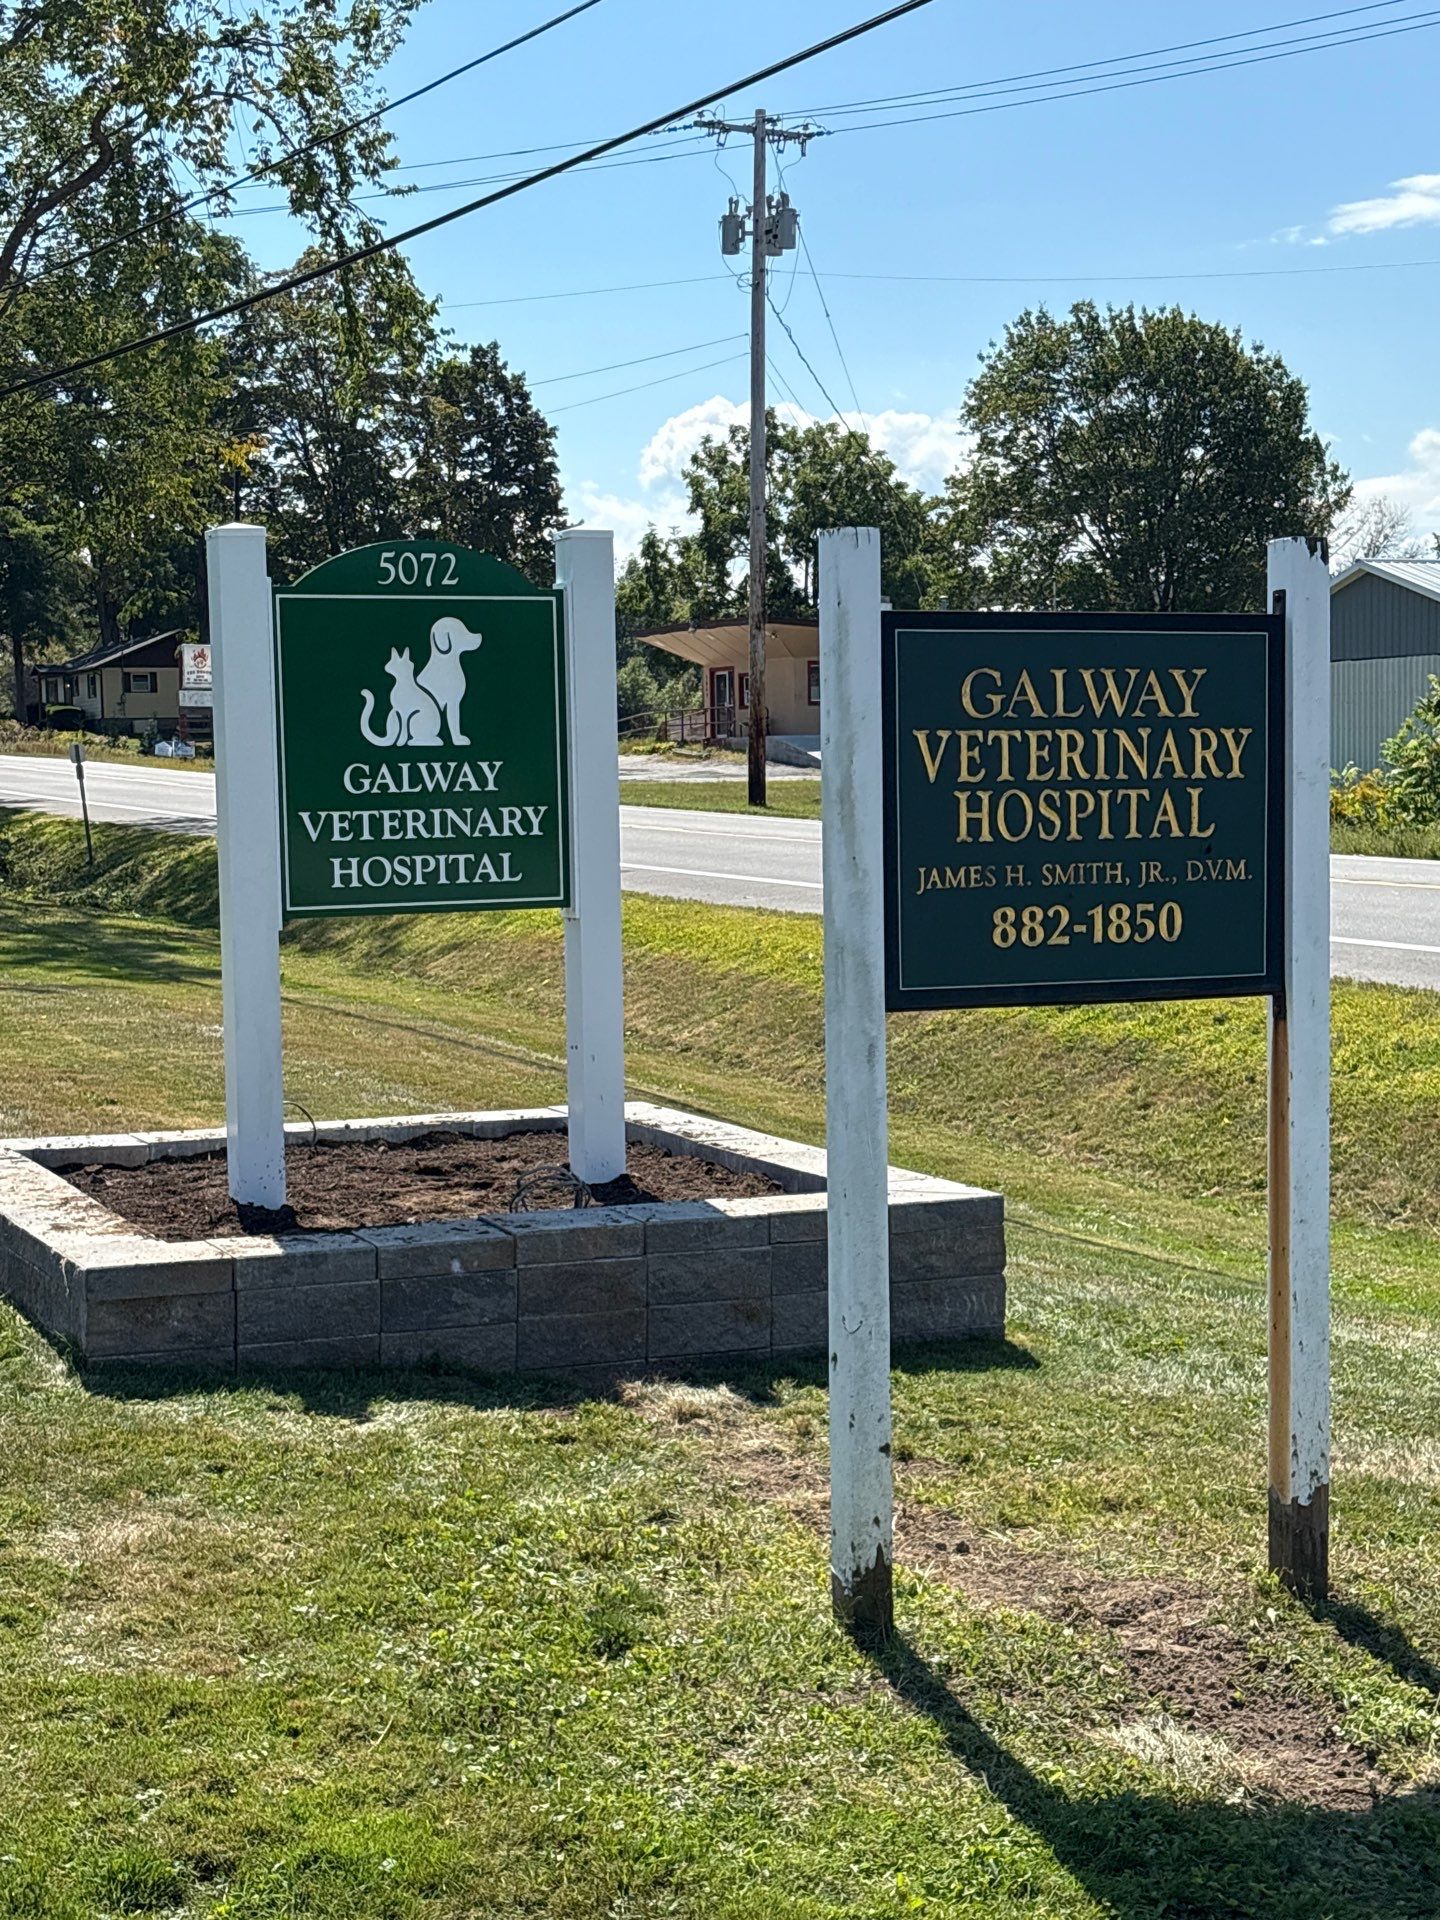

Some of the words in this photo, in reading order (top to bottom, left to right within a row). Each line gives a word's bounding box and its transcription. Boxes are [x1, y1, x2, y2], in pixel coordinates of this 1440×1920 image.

[377, 551, 459, 587] 5072
[961, 667, 1207, 719] GALWAY
[913, 727, 1252, 783] VETERINARY
[343, 761, 503, 794] GALWAY
[298, 806, 548, 842] VETERINARY
[953, 787, 1215, 842] HOSPITAL
[329, 852, 522, 888] HOSPITAL
[916, 864, 997, 895] JAMES
[1005, 864, 1032, 887] H.
[1041, 861, 1130, 887] SMITH,
[1138, 861, 1178, 888] JR.,
[1186, 858, 1253, 882] D.V.M.
[992, 901, 1183, 948] 882-1850
